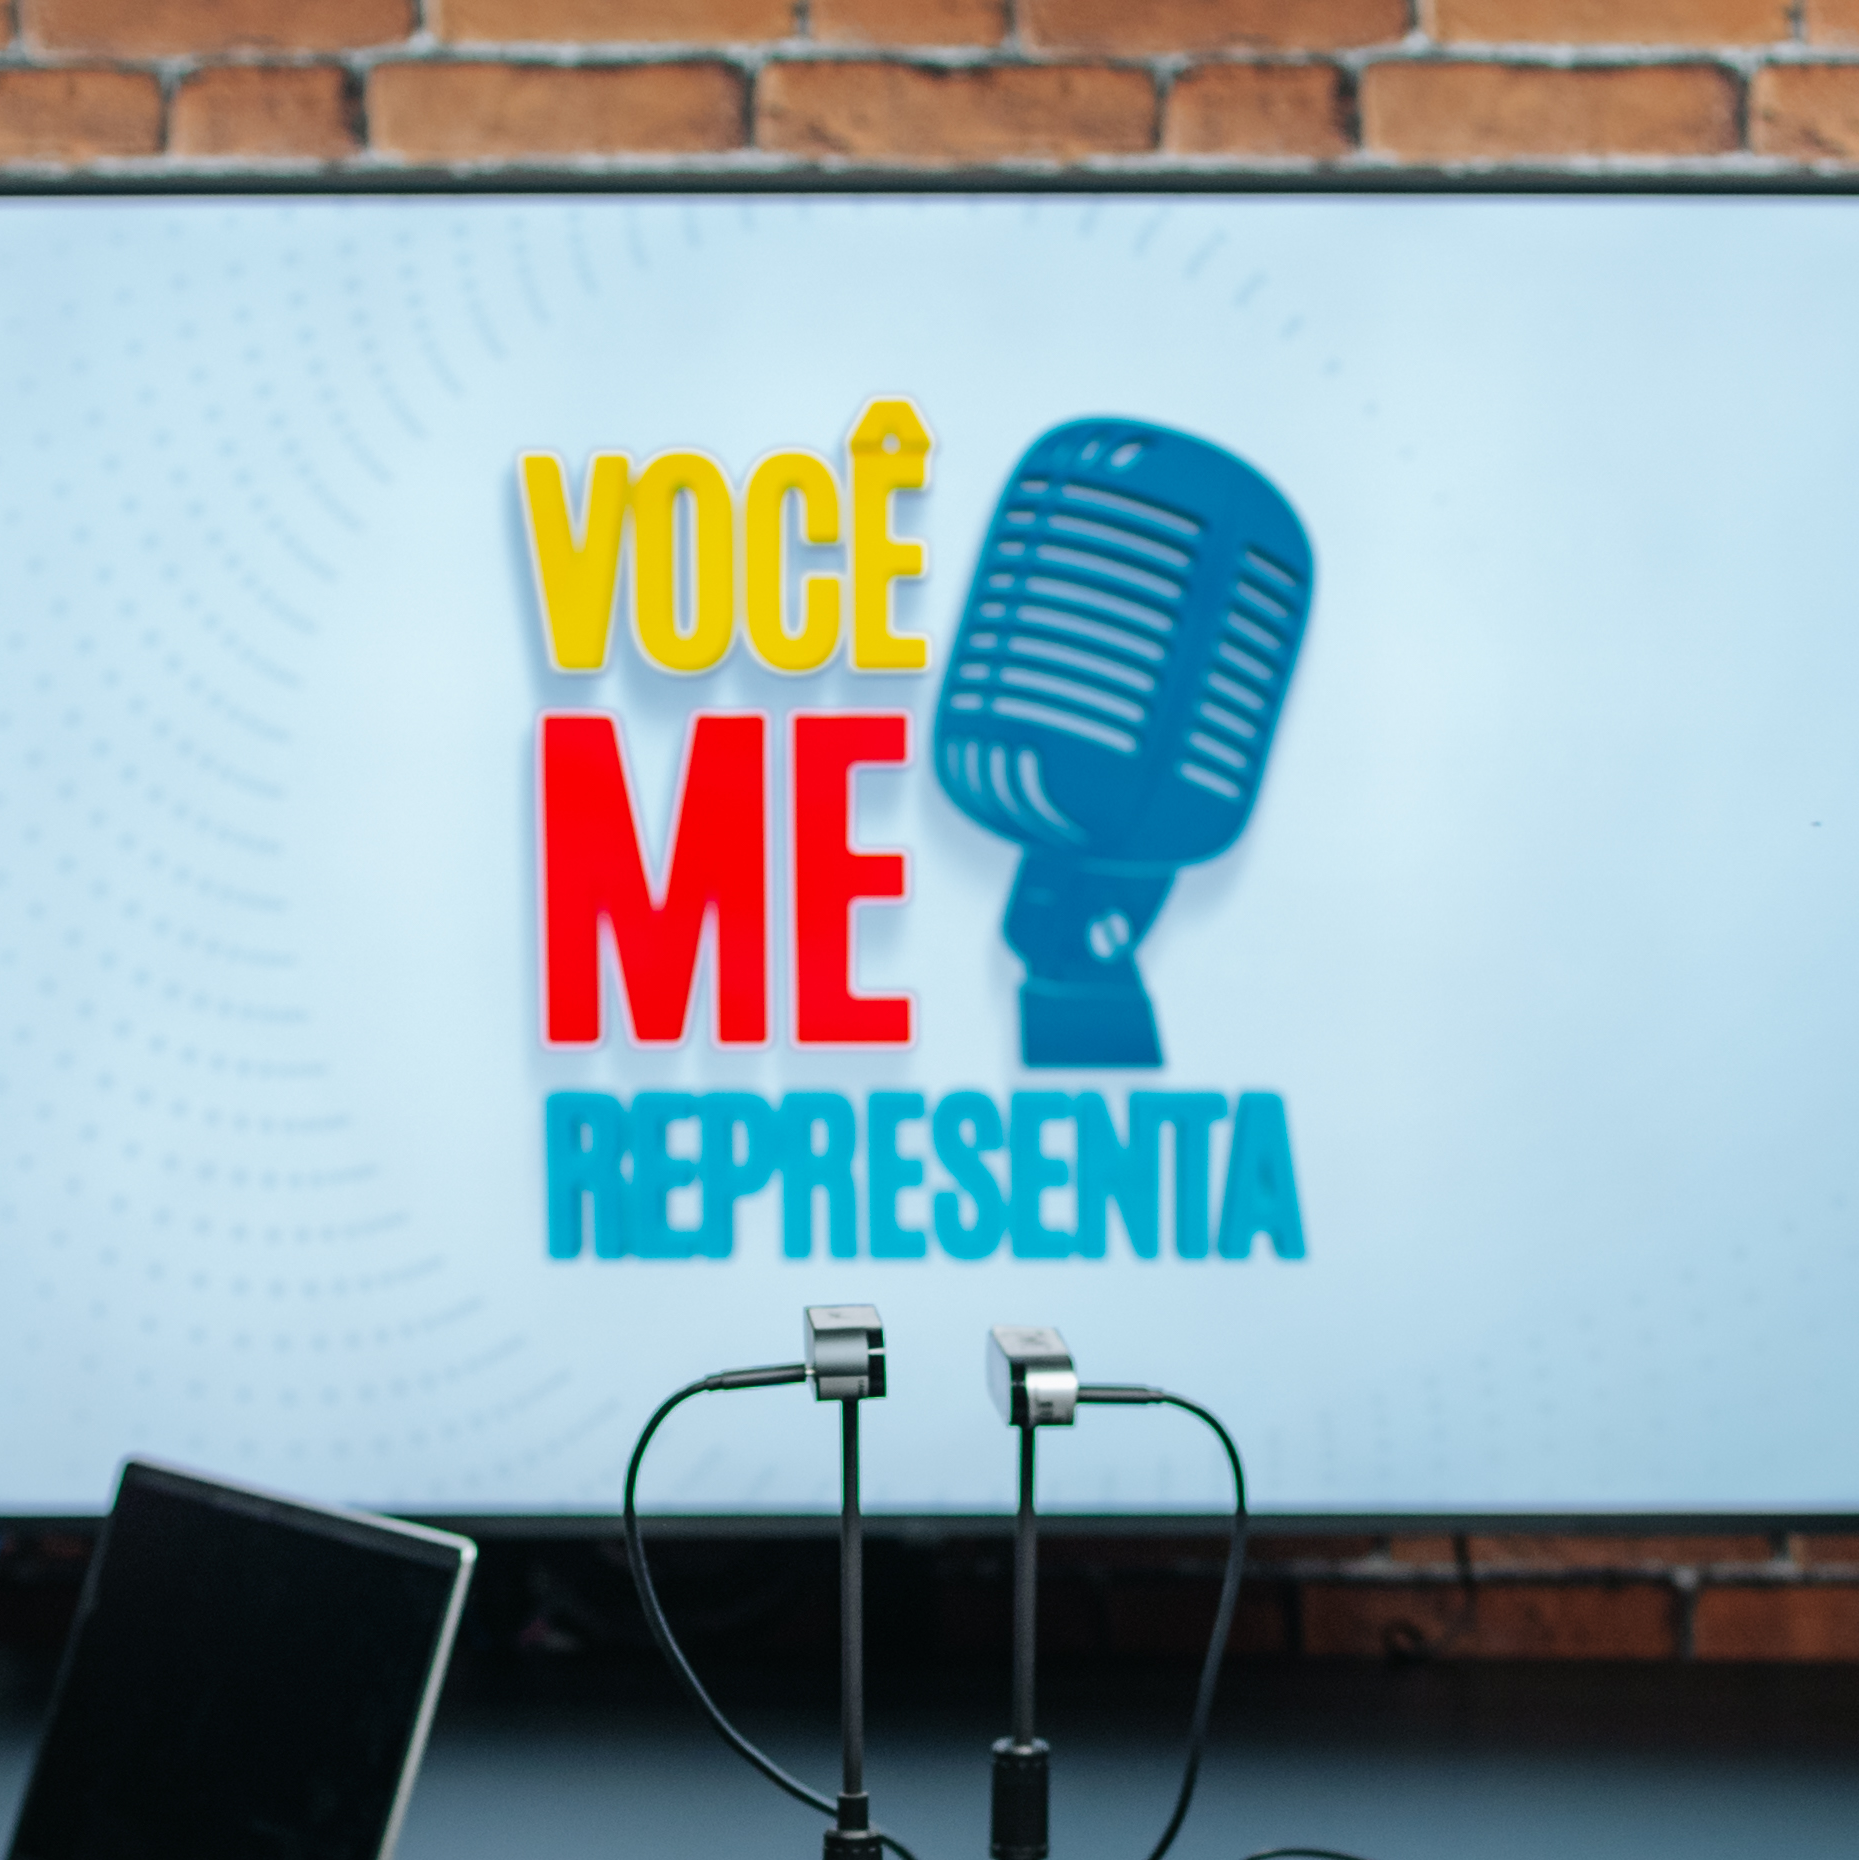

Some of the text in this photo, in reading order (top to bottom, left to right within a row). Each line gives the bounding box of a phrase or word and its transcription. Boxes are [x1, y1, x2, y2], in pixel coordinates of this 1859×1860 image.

[522, 399, 932, 670] VOCÊ
[542, 714, 911, 1044] ME
[545, 1090, 1307, 1260] REPRESENTA
